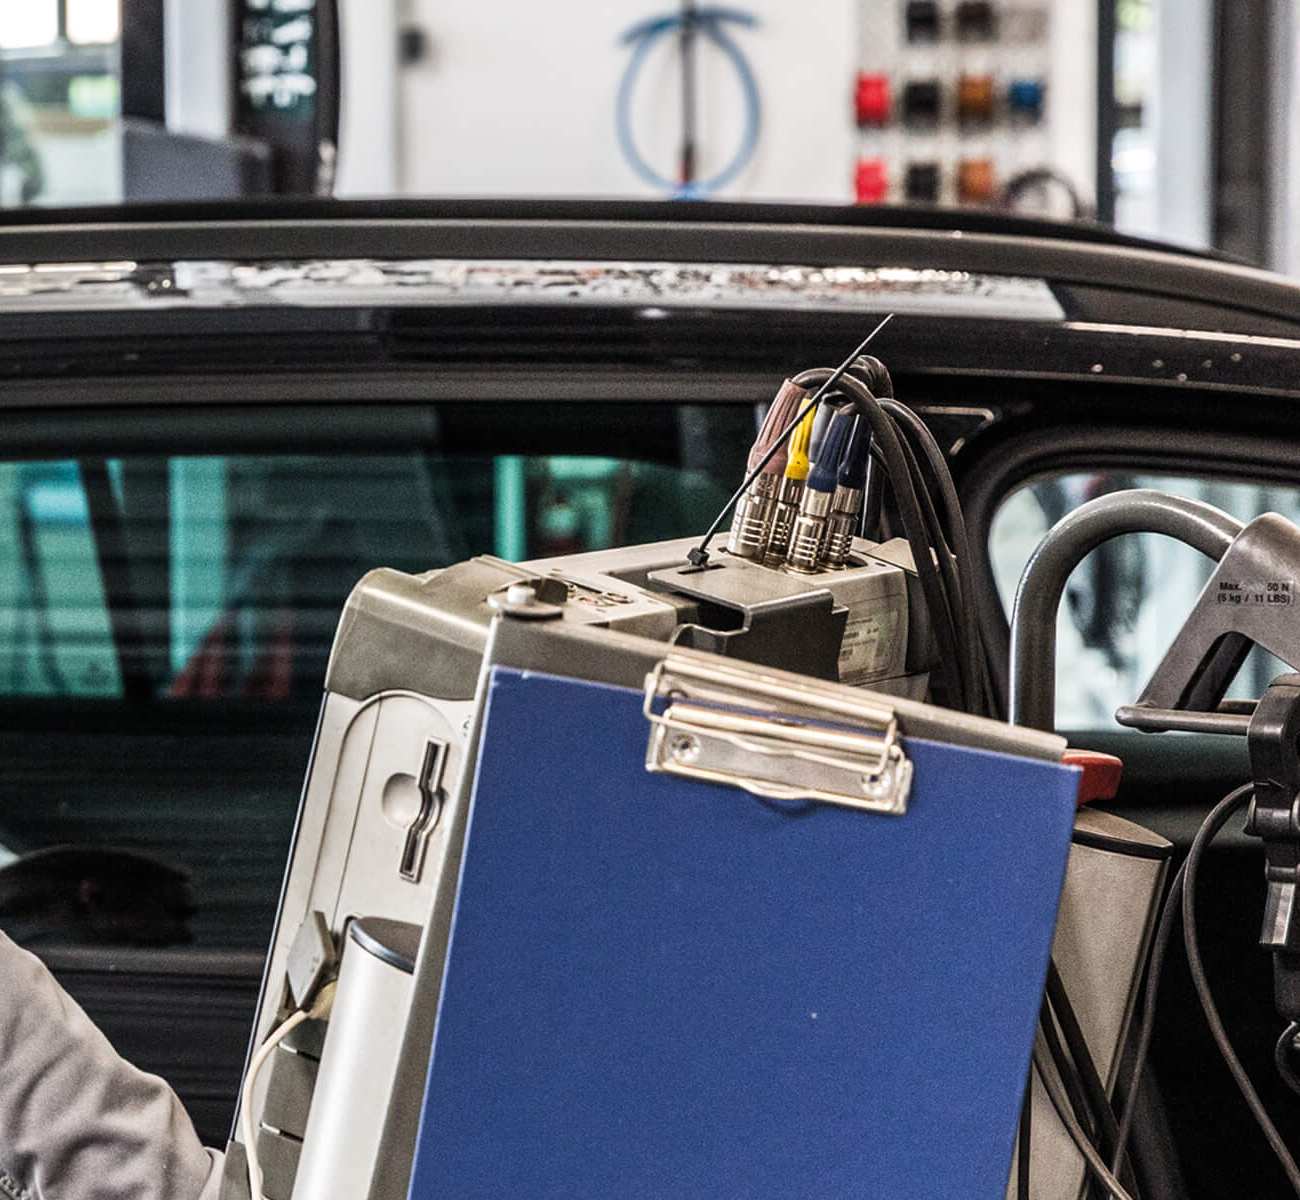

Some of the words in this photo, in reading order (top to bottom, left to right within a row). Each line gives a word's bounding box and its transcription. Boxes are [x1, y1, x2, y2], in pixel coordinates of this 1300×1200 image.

[1219, 582, 1241, 591] Max.
[1267, 582, 1279, 591] 50
[1281, 583, 1290, 591] N
[1217, 593, 1227, 604] (5
[1228, 593, 1241, 604] kg
[1254, 594, 1264, 603] 11
[1267, 594, 1291, 605] LBS)
